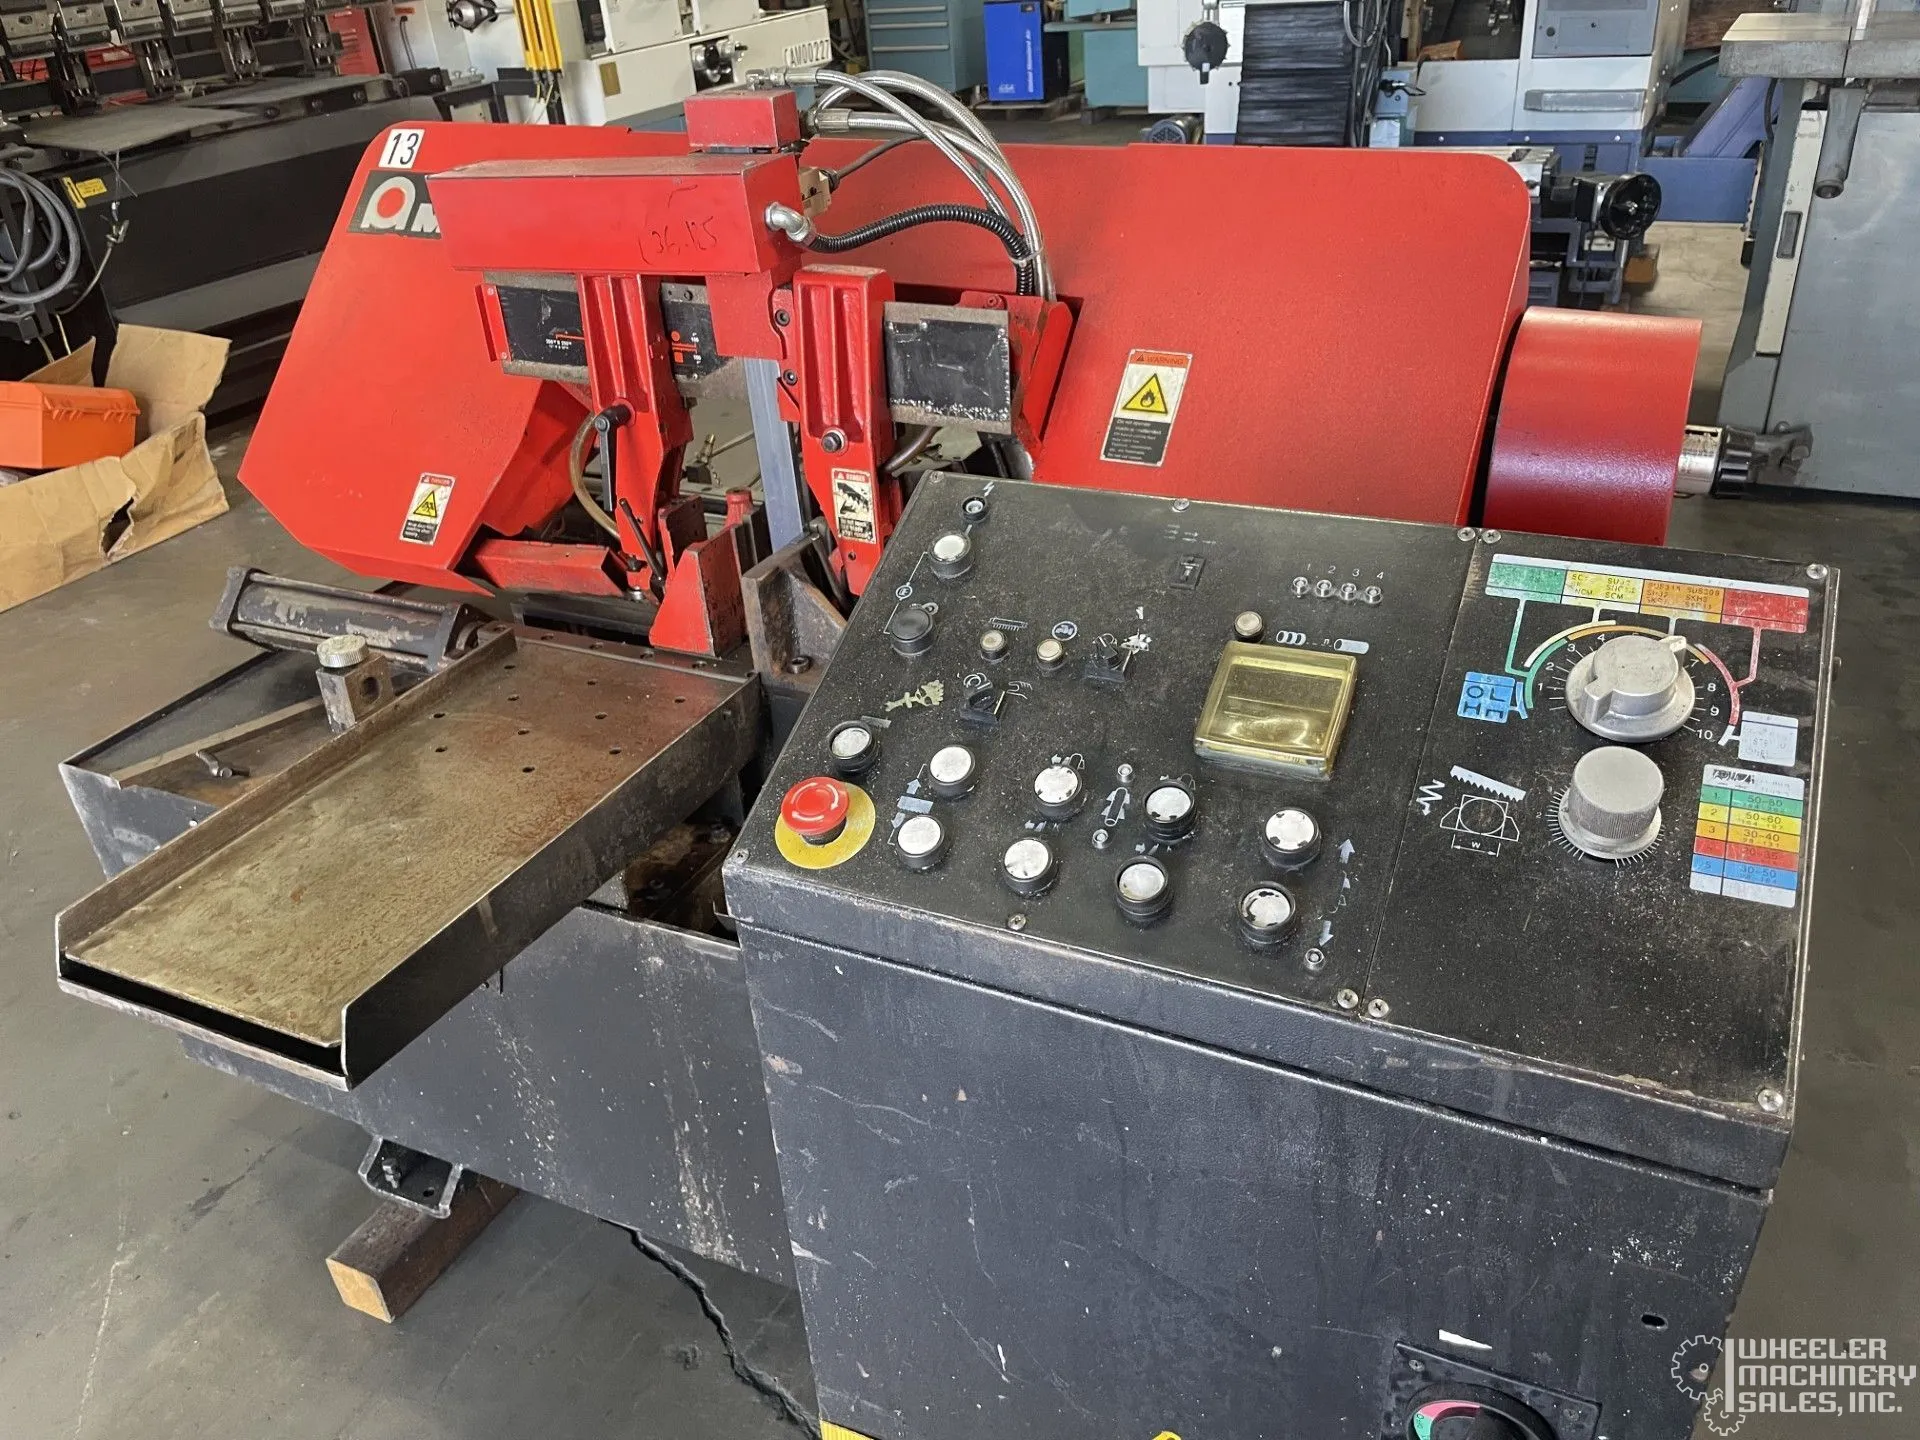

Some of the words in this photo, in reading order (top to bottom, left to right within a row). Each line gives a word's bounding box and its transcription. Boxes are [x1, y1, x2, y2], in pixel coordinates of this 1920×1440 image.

[387, 132, 419, 165] 13
[1147, 356, 1184, 365] WARNING
[1328, 565, 1336, 574] 2
[1352, 568, 1360, 577] 3
[1376, 571, 1384, 580] 4
[1597, 633, 1606, 642] 4
[1567, 643, 1576, 652] 3
[1546, 662, 1555, 671] 2
[1690, 659, 1700, 668] 7
[1538, 682, 1543, 691] 1
[1707, 682, 1717, 692] 8
[1710, 705, 1720, 716] 9
[1696, 729, 1713, 740] 10
[1535, 811, 1542, 819] 2
[1710, 808, 1718, 816] 2
[1708, 826, 1716, 834] 3
[1471, 841, 1481, 849] W
